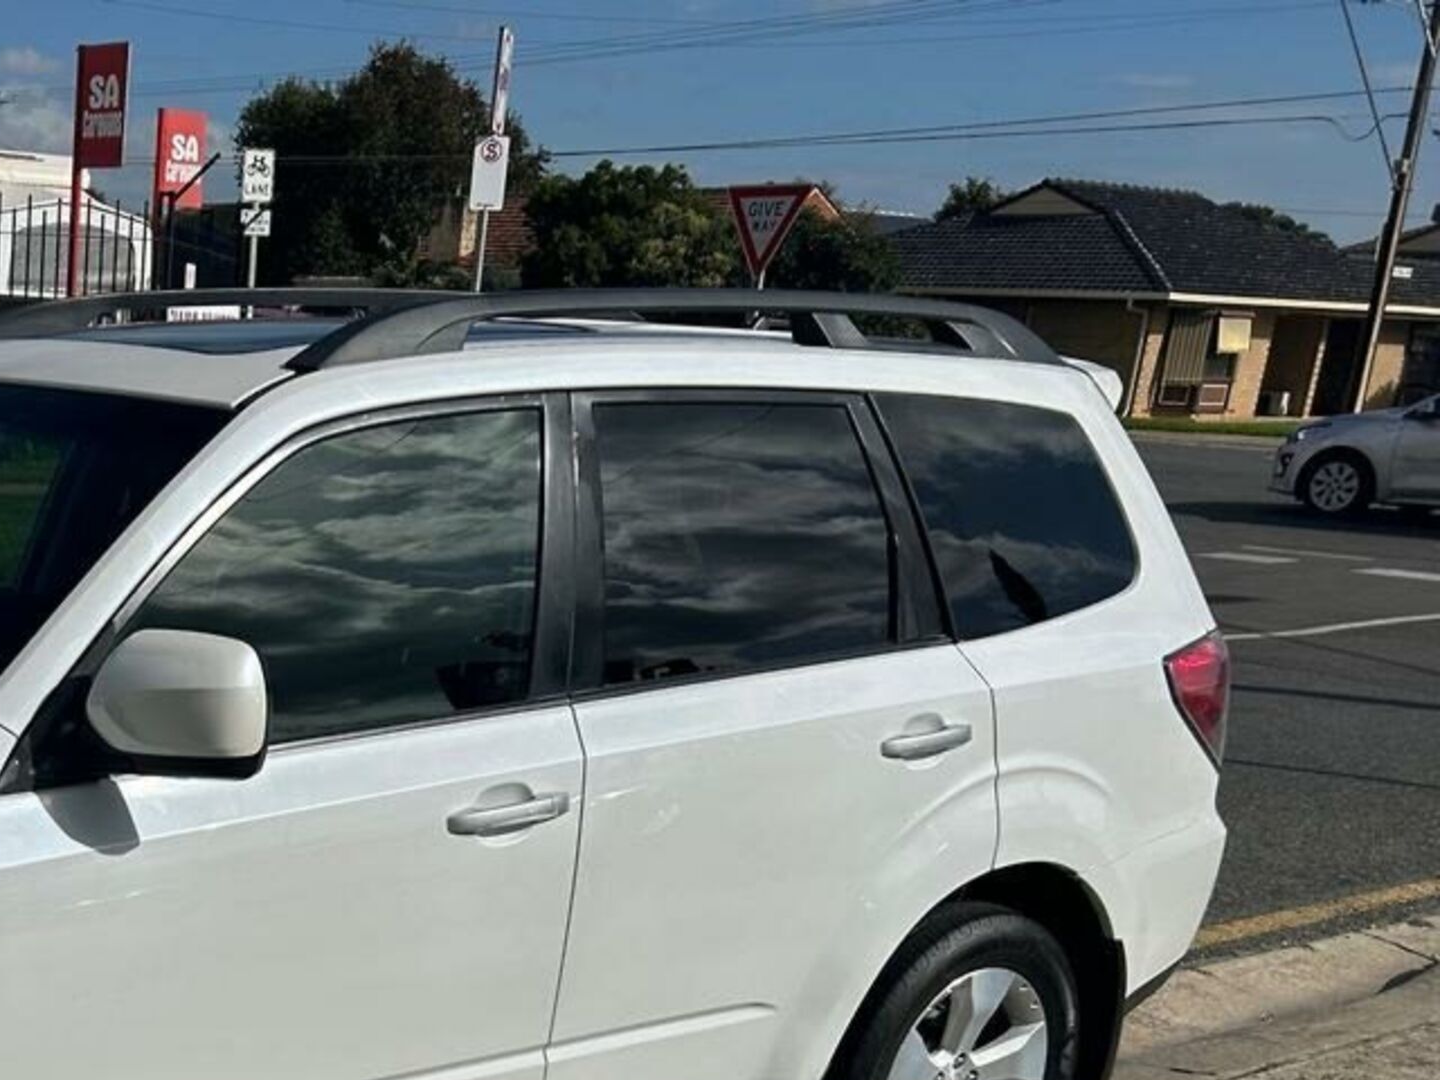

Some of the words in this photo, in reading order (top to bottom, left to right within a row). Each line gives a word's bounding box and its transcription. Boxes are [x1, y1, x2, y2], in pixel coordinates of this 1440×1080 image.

[89, 74, 120, 109] SA
[171, 133, 199, 162] SA
[748, 200, 784, 216] GIVE
